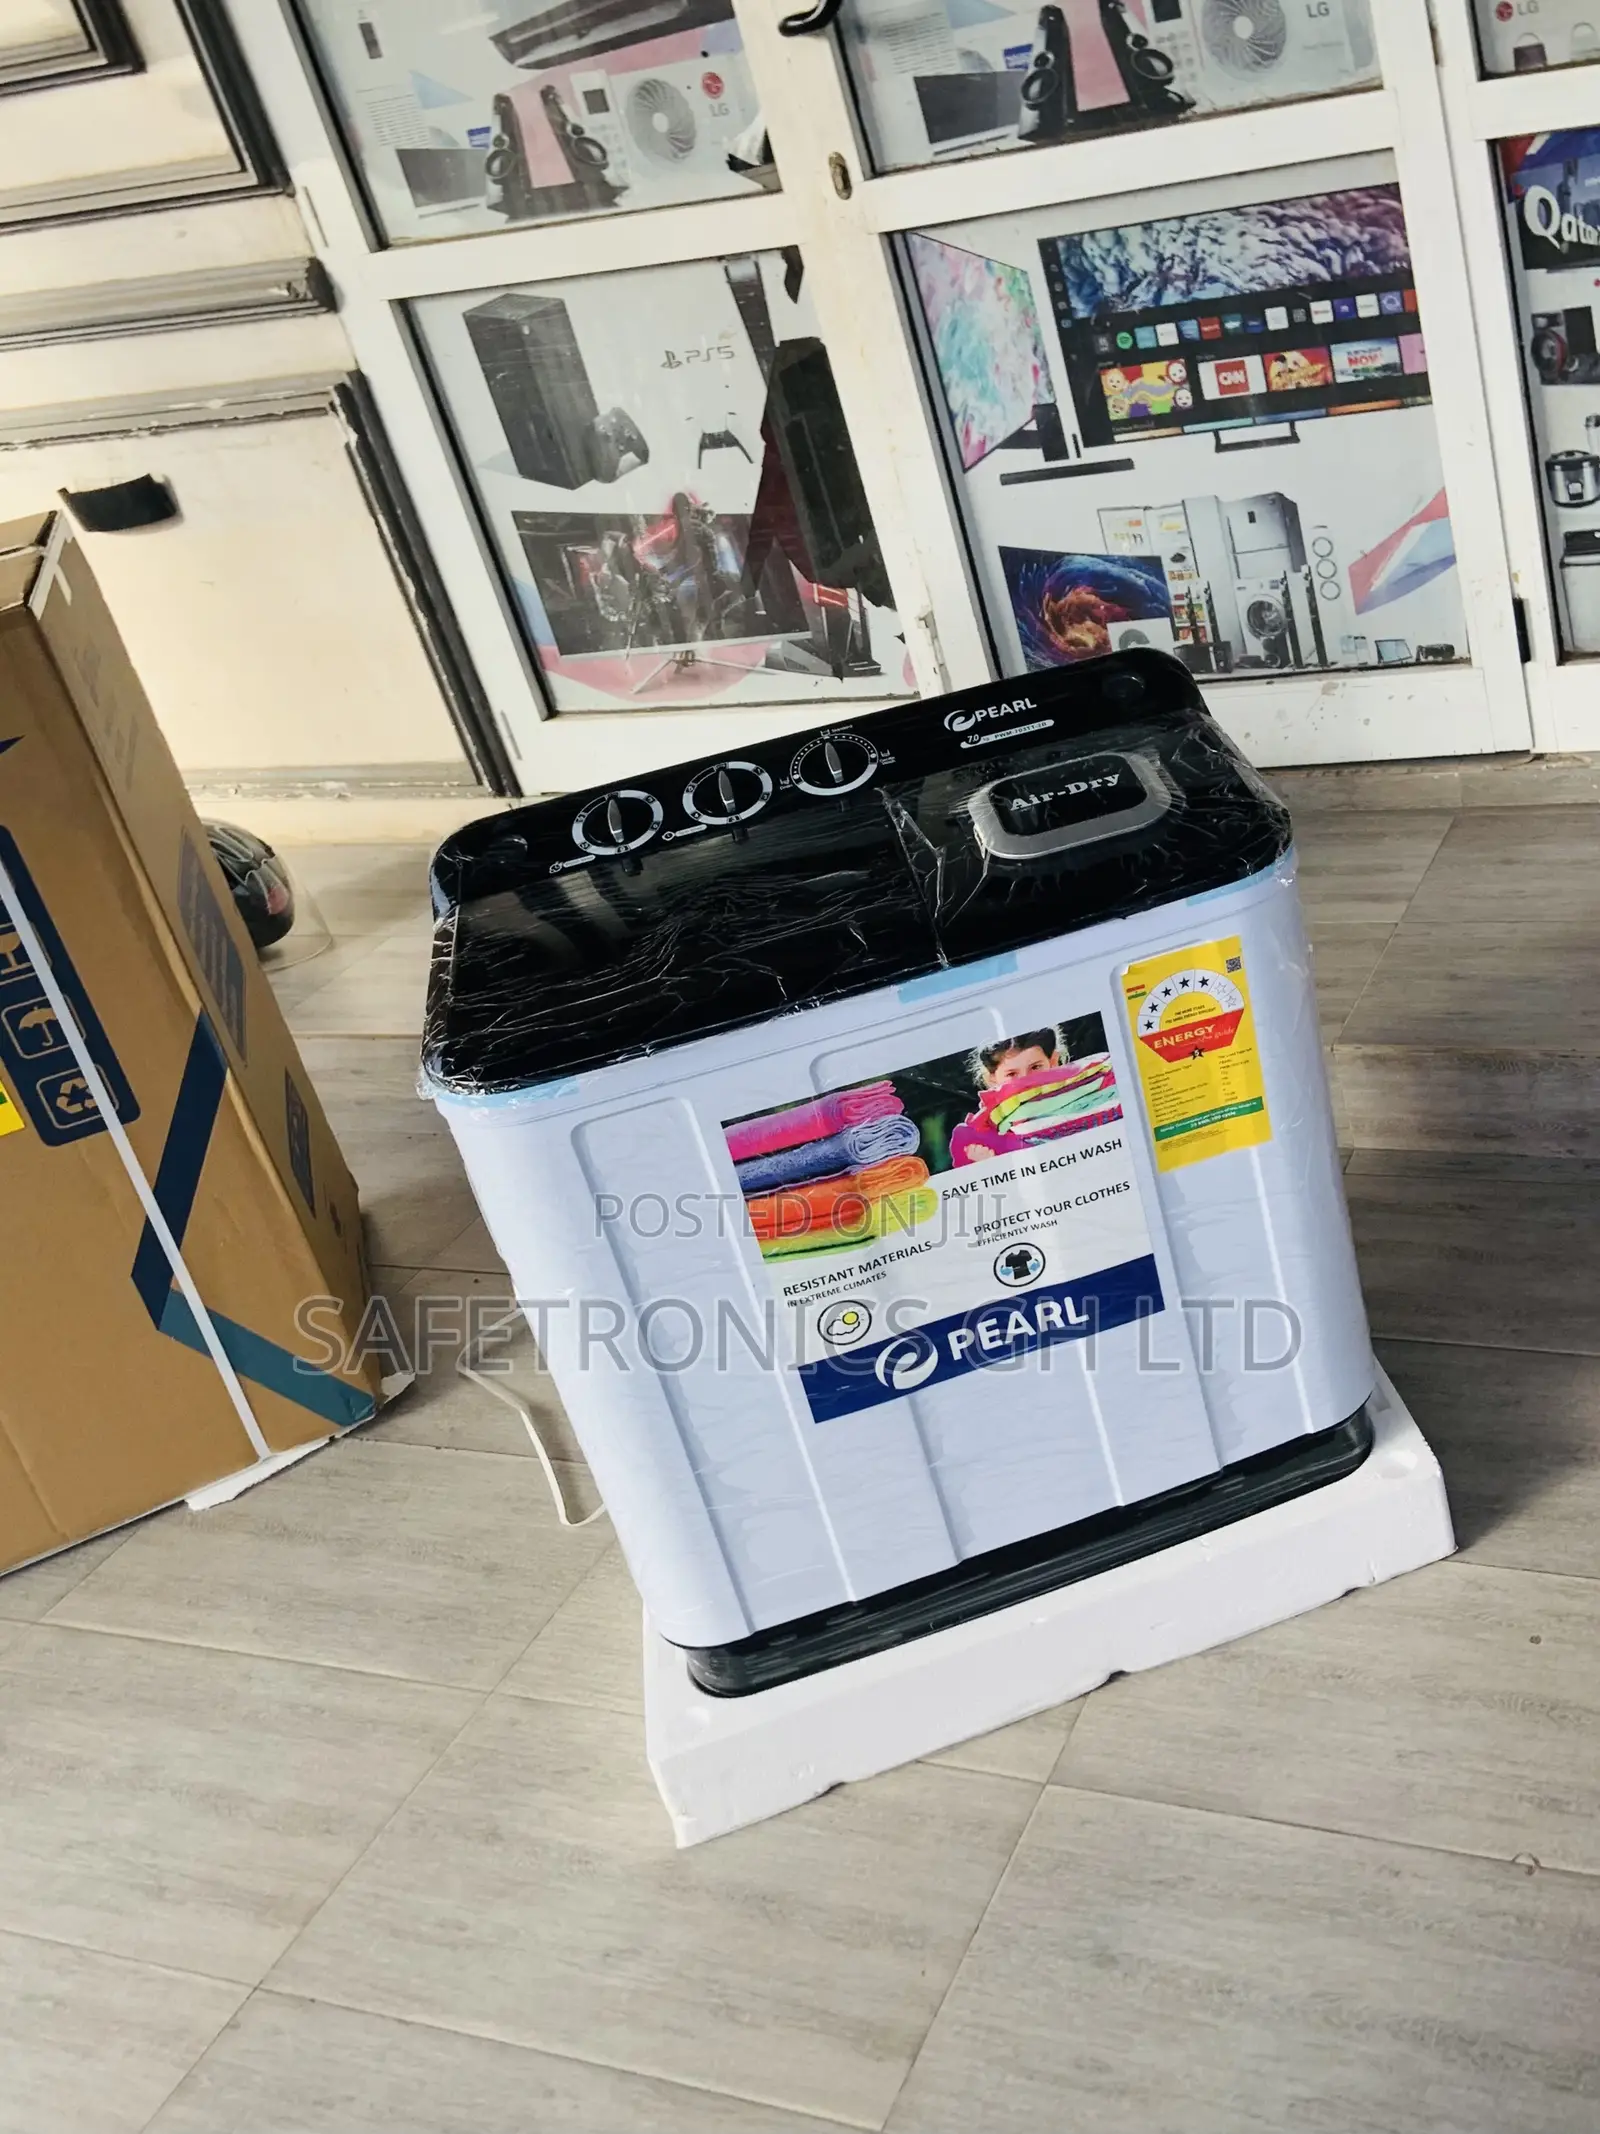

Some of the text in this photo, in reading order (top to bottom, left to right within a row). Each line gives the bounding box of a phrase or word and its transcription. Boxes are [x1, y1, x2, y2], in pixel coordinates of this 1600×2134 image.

[684, 345, 734, 363] PS5
[1217, 370, 1247, 386] CNN
[975, 698, 1037, 722] PEARL
[1010, 773, 1121, 812] Air-Dry
[1153, 1024, 1216, 1049] ENERGY
[942, 1138, 1123, 1201] SAVE TIME IN EACH WASH
[973, 1180, 1131, 1236] PROTECT YOUR CLOTHES
[976, 1218, 1059, 1248] EFFICIENTLY WASH
[782, 1239, 934, 1297] RESISTANT MATERIALS
[786, 1269, 888, 1309] IN EXTREME CLIMATES
[948, 1296, 1090, 1361] PEARL
